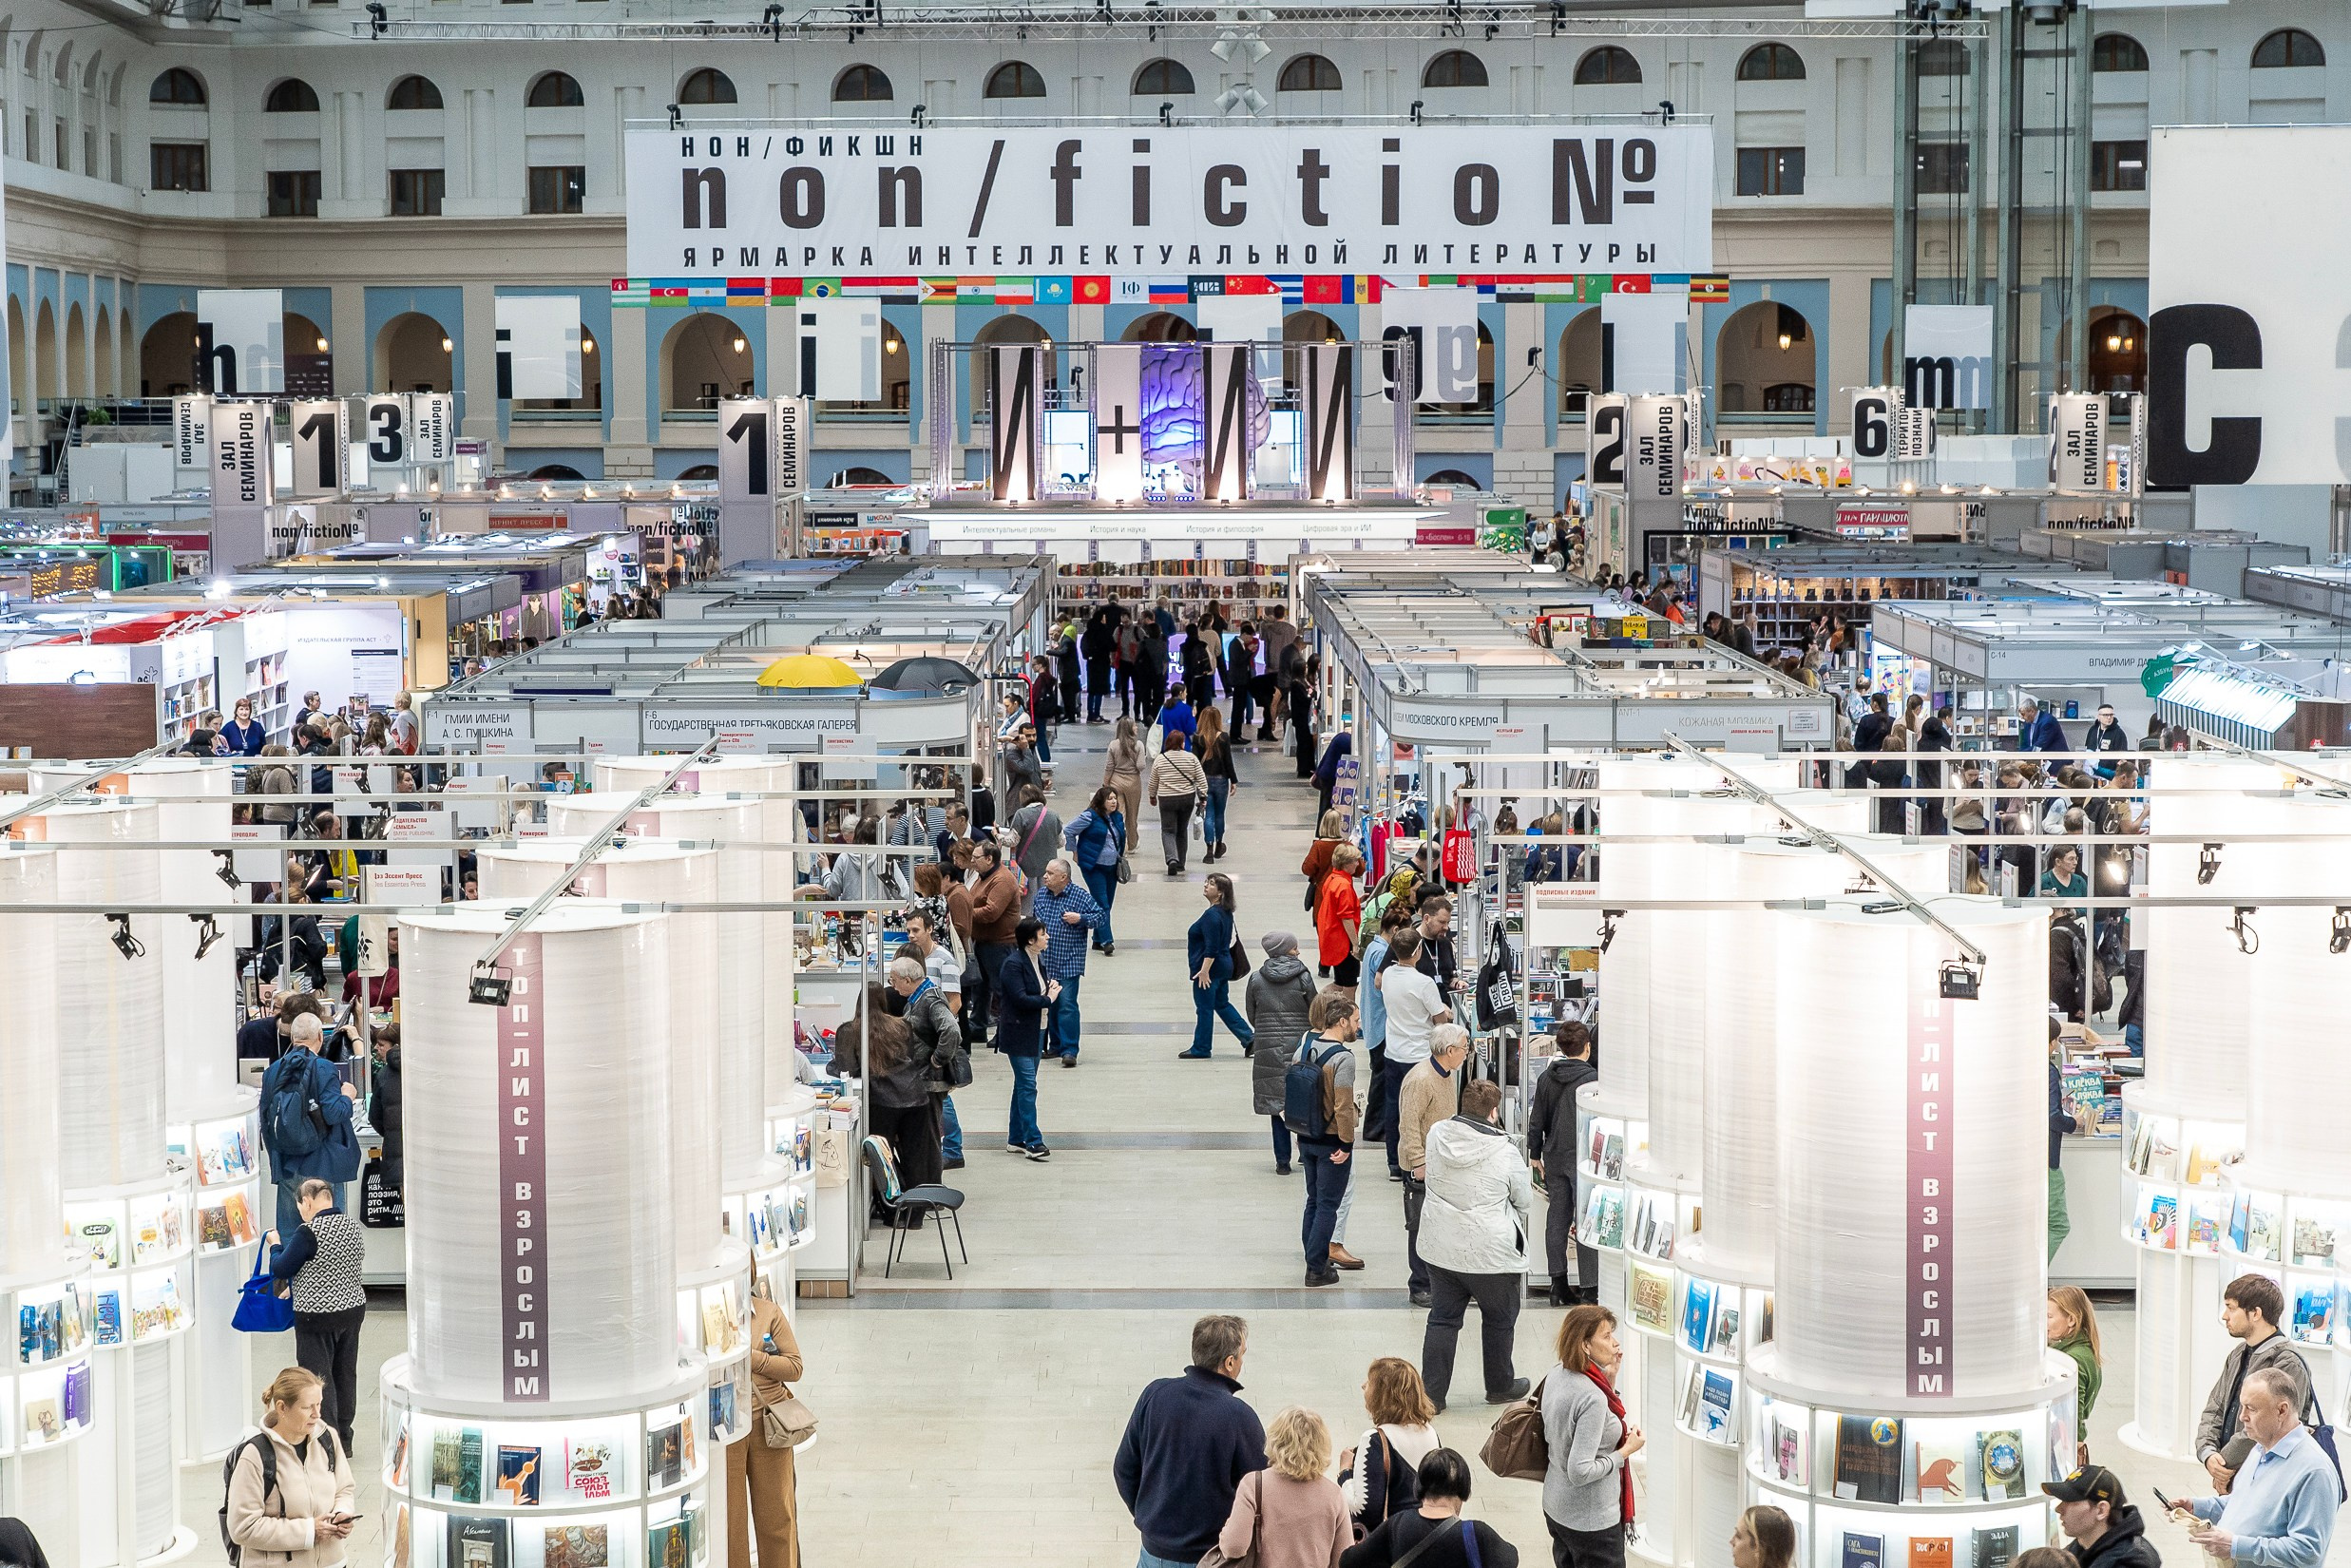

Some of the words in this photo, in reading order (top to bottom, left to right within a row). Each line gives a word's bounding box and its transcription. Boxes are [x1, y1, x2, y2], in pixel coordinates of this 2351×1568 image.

[681, 135, 923, 157] НОН/ФИКШН
[683, 245, 874, 267] ЯРМАРКА
[908, 239, 1348, 267] ИНТЕЛЛЕКТУАЛЬНОЙ
[1383, 242, 1656, 265] ЛИТЕРАТУРЫ
[181, 402, 192, 465] СЕМИНАРОВ
[194, 423, 204, 445] ЗАЛ
[370, 404, 403, 462] 3
[420, 419, 430, 439] ЗАЛ
[432, 399, 443, 459] СЕМИНАРОВ
[1855, 398, 1888, 457] 6
[1912, 409, 1922, 456] ПОЗНАНИ
[221, 441, 236, 470] ЗАЛ
[297, 413, 337, 488] 1
[726, 412, 768, 494] 1
[783, 406, 796, 488] СЕМИНАРОВ
[1640, 436, 1654, 466] ЗАЛ
[1659, 406, 1673, 495] СЕМИНАРОВ
[2067, 430, 2080, 456] ЗАЛ
[2084, 403, 2099, 486] СЕМИНАРОВ
[240, 411, 256, 502] СЕМИНАРОВ
[963, 525, 1028, 535] Интеллектуальные
[1090, 525, 1119, 535] История
[1186, 524, 1215, 535] История
[1223, 524, 1265, 535] философия
[1303, 524, 1339, 535] Цифровая
[1340, 526, 1352, 535] эра
[1360, 524, 1372, 533] ИИ
[2089, 658, 2136, 668] ВЛАДИМИР
[445, 714, 472, 724] ГМИИ
[475, 713, 510, 723] ИМЕНИ
[645, 711, 658, 719] F-6
[649, 719, 736, 732] ГОСУДАРСТВЕННАЯ
[817, 719, 856, 731] ГАЛЕРЕЯ
[1405, 714, 1458, 726] МОСКОВСКОГО
[1460, 717, 1499, 727] КРЕМЛЯ
[1678, 717, 1725, 727] КОЖАНАЯ
[442, 729, 451, 738] А.
[454, 729, 463, 738] С.
[466, 727, 514, 738] ПУШКИНА
[514, 1182, 540, 1396] ВЗРОСЛЫМ
[1919, 1178, 1943, 1393] ВЗРОСЛЫМ
[574, 1482, 610, 1491] УЛЬТ
[575, 1476, 607, 1485] СОЮЗ
